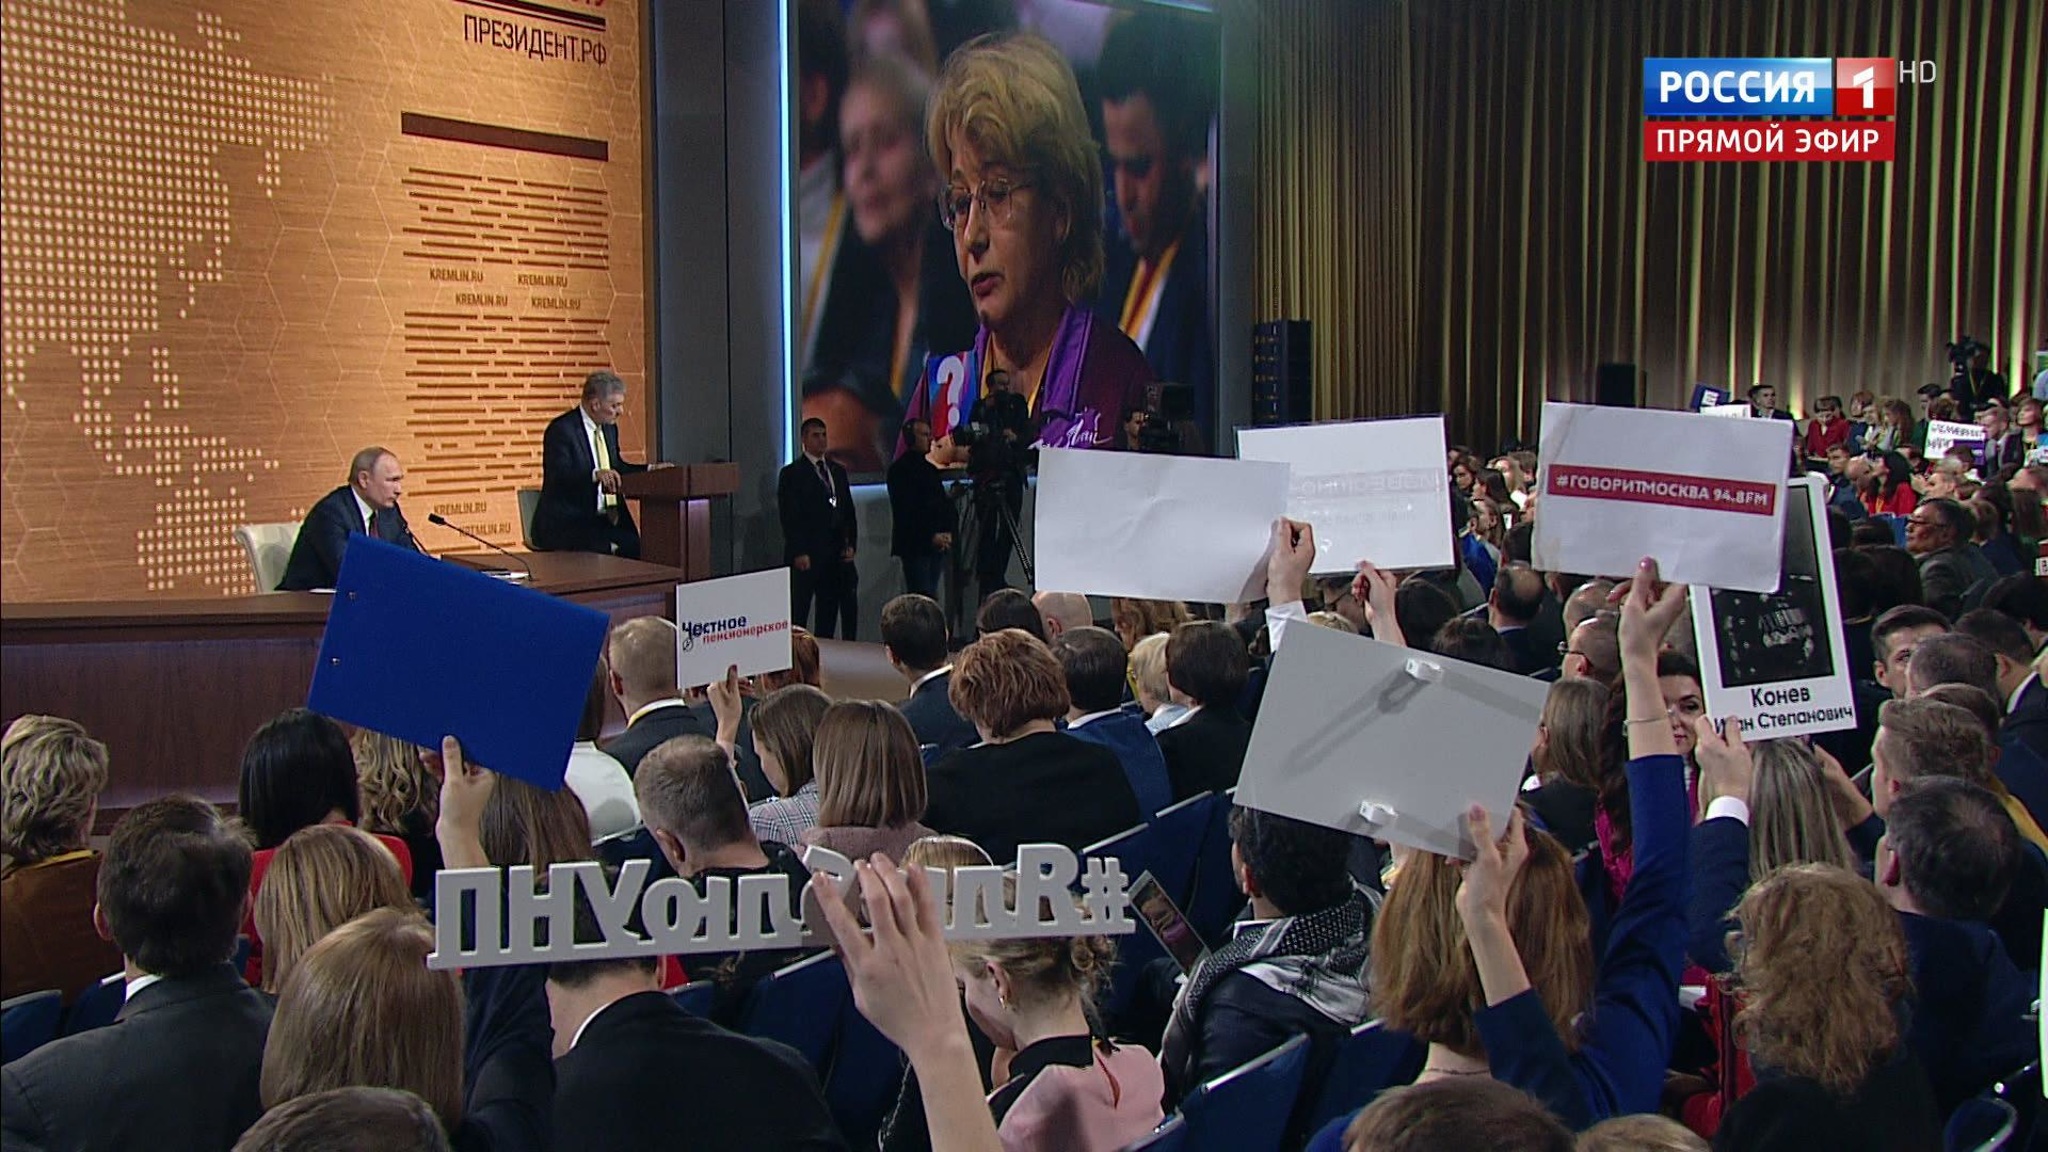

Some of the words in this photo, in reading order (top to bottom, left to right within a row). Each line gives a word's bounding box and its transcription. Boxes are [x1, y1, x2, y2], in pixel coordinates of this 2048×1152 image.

[464, 14, 607, 66] ПРЕЗИДЕНТ.РФ
[430, 269, 483, 282] KREMLIN.RU
[517, 274, 568, 287] KREMLIN.RU
[455, 293, 508, 307] KREMLIN.RU
[531, 297, 581, 310] KREMLIN.RU
[1556, 474, 1710, 500] #ГОВОРИТМОСКВА
[1713, 488, 1768, 506] 94.8FM
[434, 502, 487, 515] KREMLIN.RU
[682, 614, 746, 637] Честное
[703, 619, 788, 644] пенсионерское
[1752, 687, 1811, 707] Конев
[1714, 717, 1756, 735] Иан
[1758, 706, 1853, 728] Степанович
